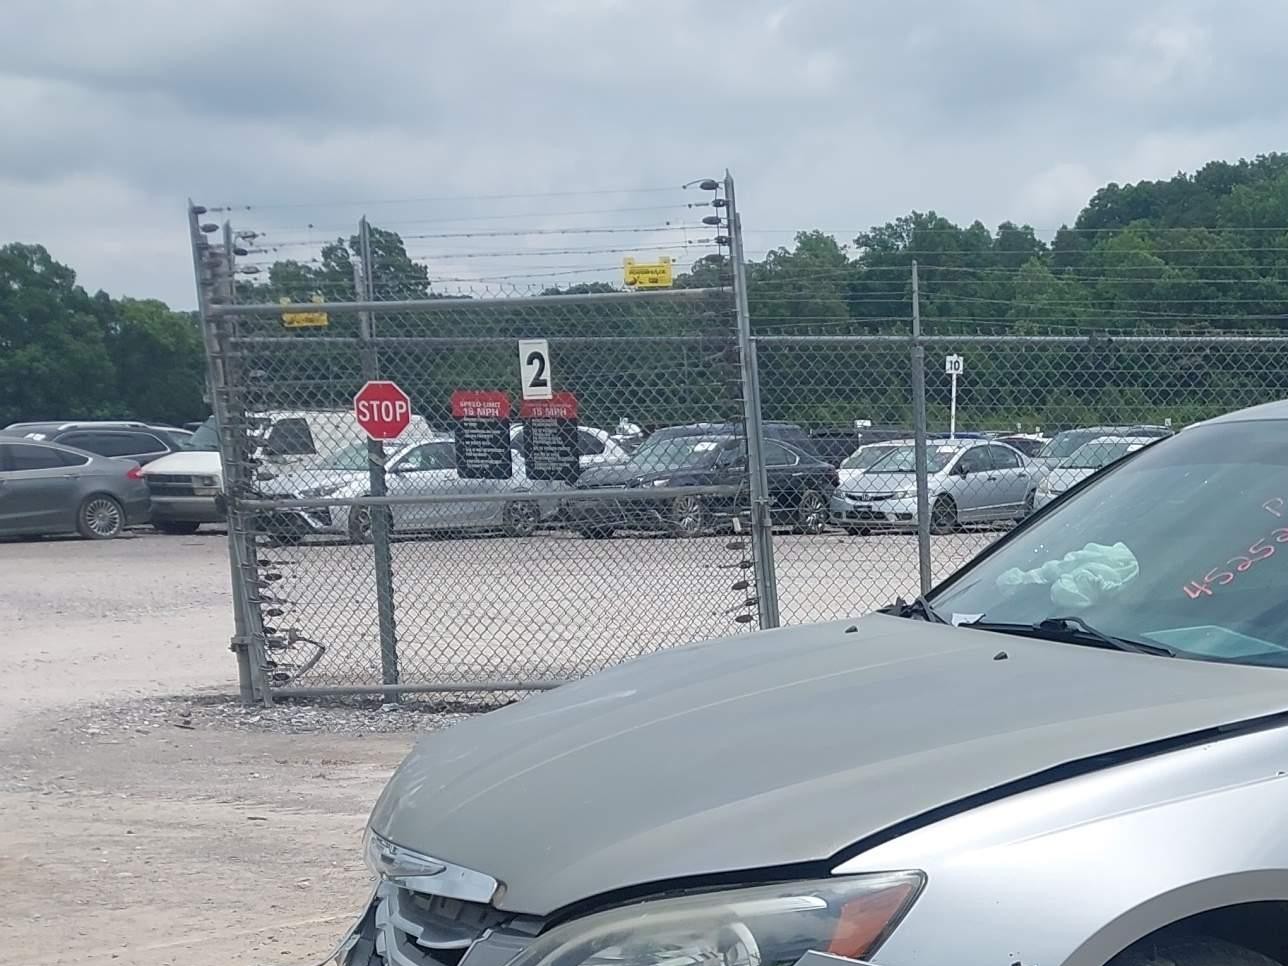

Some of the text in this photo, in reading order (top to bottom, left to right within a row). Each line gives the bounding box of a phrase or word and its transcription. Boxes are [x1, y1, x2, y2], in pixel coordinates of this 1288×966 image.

[526, 351, 547, 388] 2
[950, 360, 960, 371] 10
[358, 400, 407, 422] STOP
[477, 407, 499, 416] MPH
[545, 407, 567, 416] MPH
